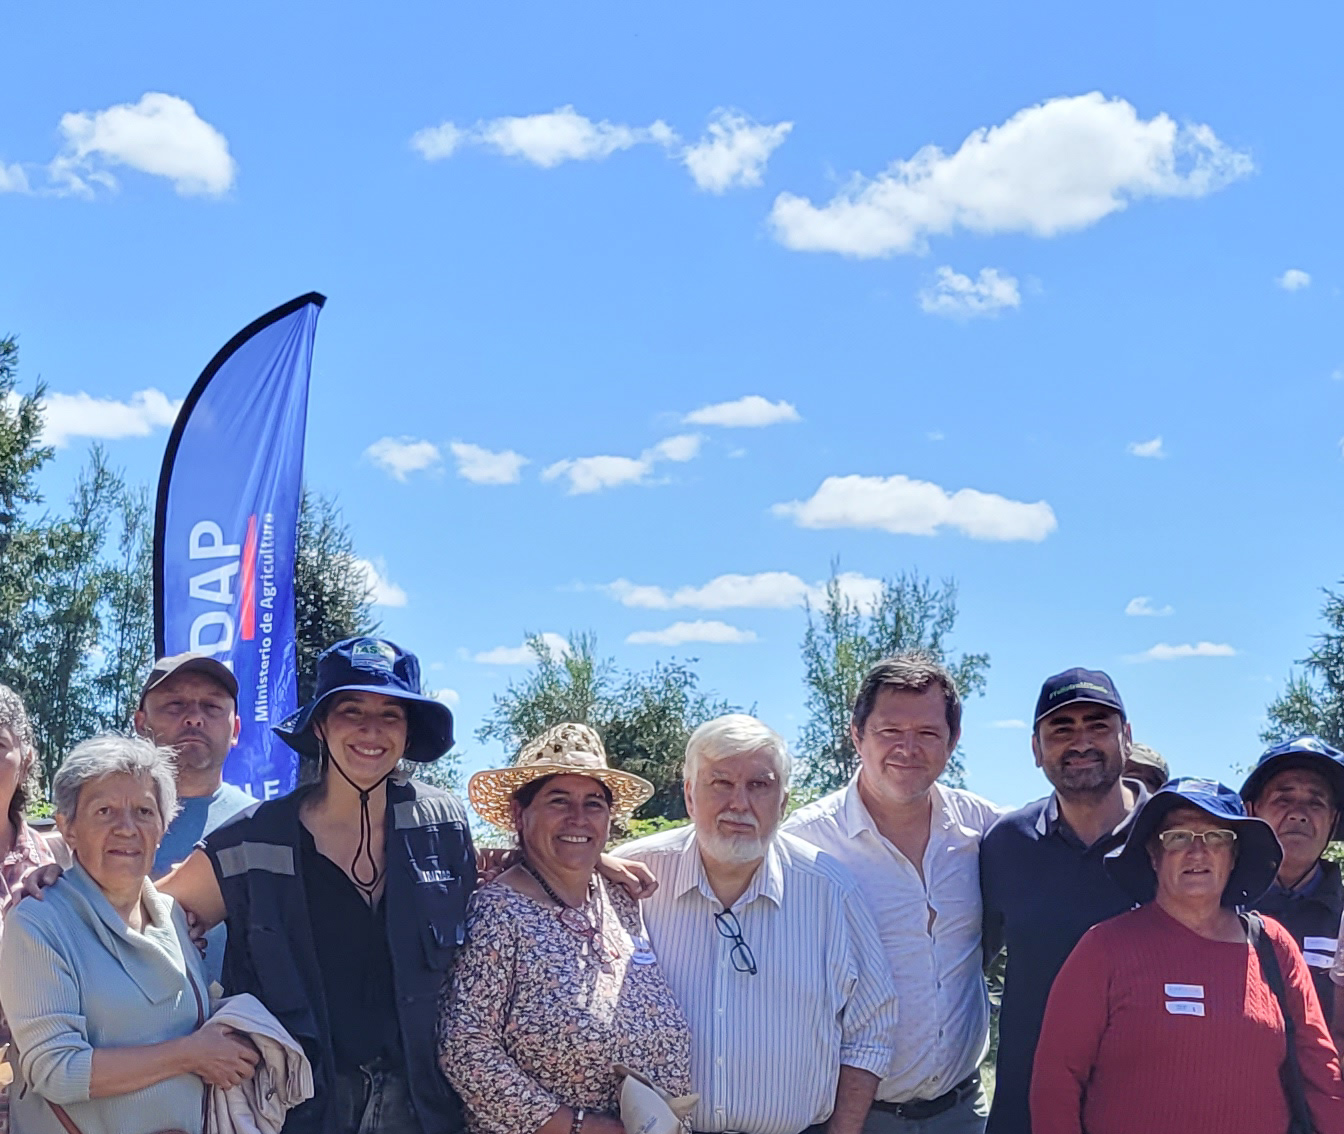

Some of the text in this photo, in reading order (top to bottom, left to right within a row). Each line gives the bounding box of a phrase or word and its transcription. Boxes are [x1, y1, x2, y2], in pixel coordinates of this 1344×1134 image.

[189, 520, 241, 673] DAP
[259, 613, 273, 634] de
[255, 637, 273, 722] Ministerio
